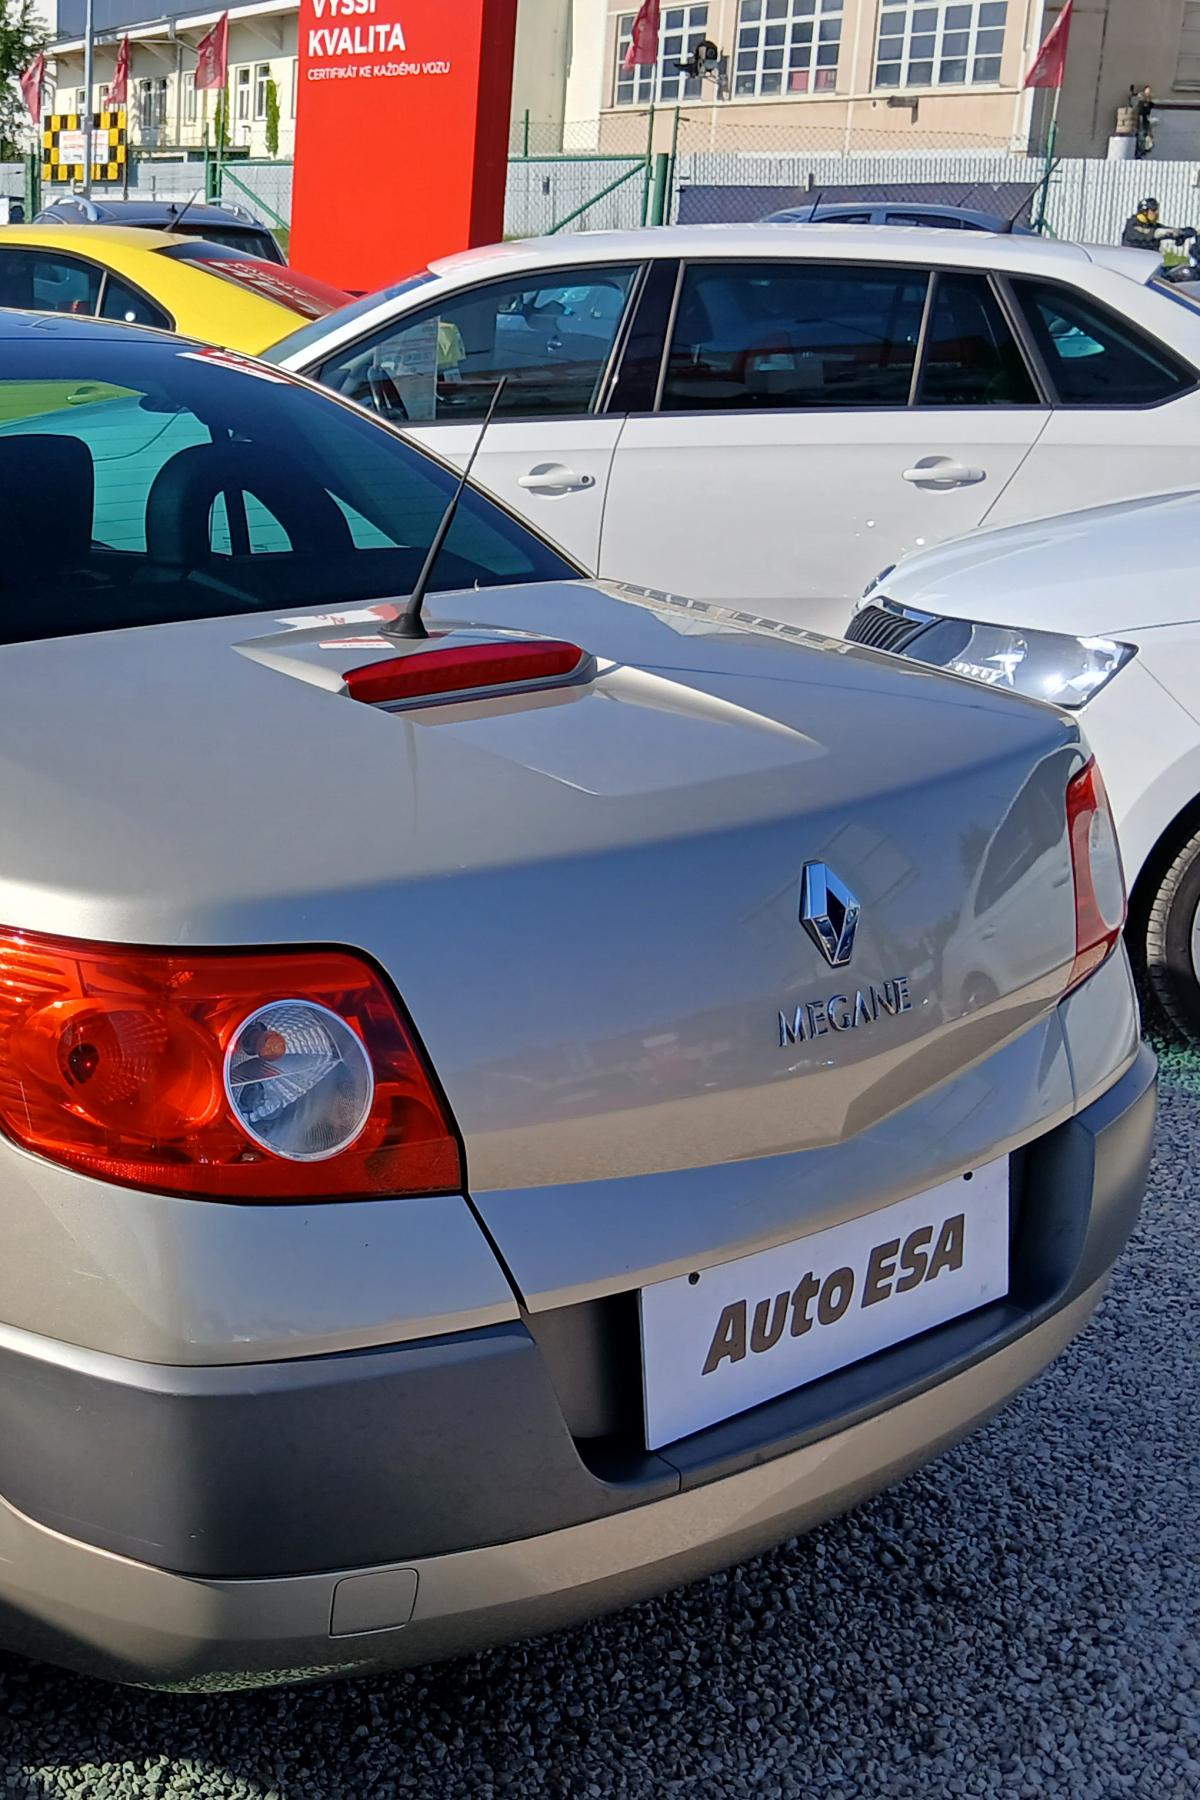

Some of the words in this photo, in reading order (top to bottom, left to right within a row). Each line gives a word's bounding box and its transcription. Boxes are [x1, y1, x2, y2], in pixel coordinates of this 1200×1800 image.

[308, 22, 406, 57] KVALITA
[307, 64, 357, 81] CERTIFIKÁT
[358, 65, 372, 77] KE
[373, 61, 420, 77] KAŽDÉMU
[421, 61, 450, 74] VOZU
[777, 976, 913, 1047] MEGANE
[701, 1266, 855, 1376] Auto
[860, 1213, 965, 1309] ESA
